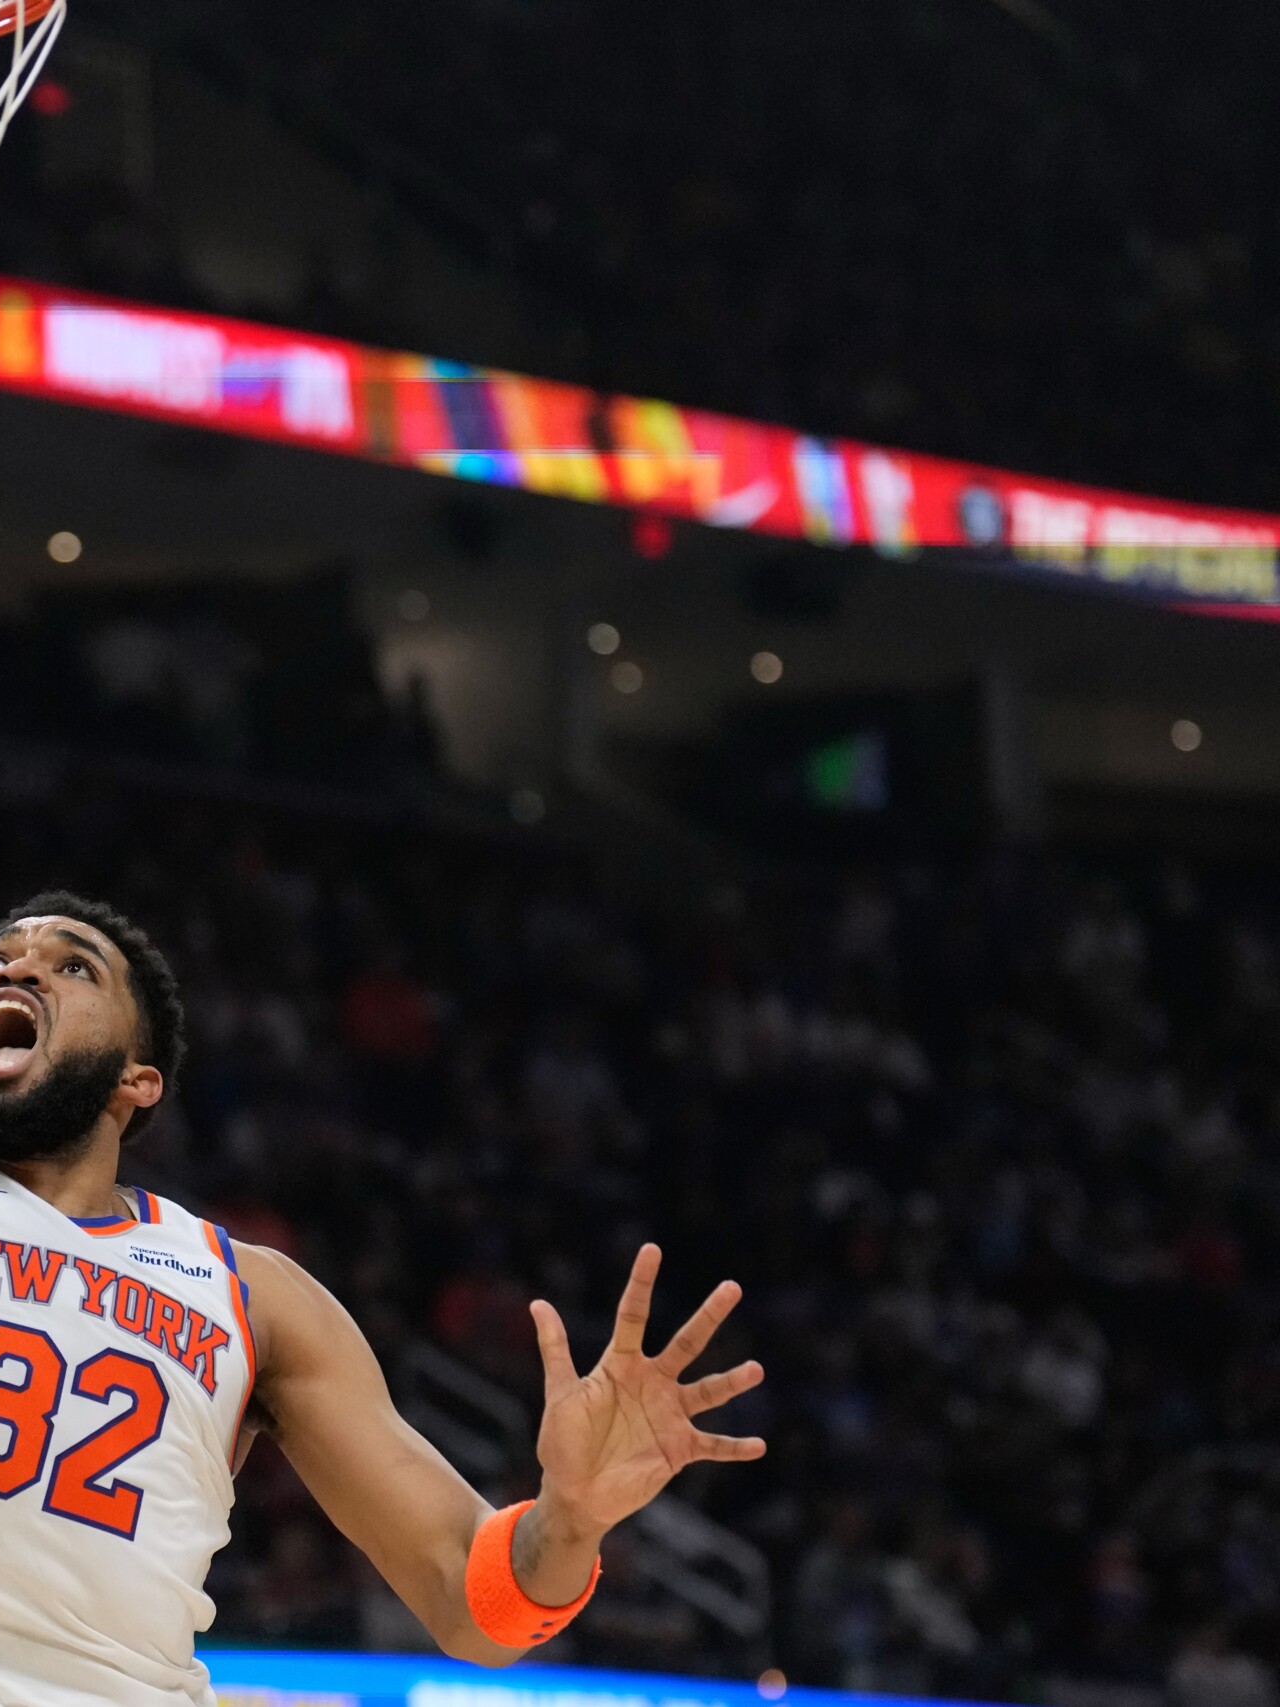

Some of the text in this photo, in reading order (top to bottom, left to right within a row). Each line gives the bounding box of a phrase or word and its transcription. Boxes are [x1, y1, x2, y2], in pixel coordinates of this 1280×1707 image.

[130, 1245, 175, 1258] experience
[129, 1253, 161, 1266] abu
[75, 1257, 231, 1401] YORK
